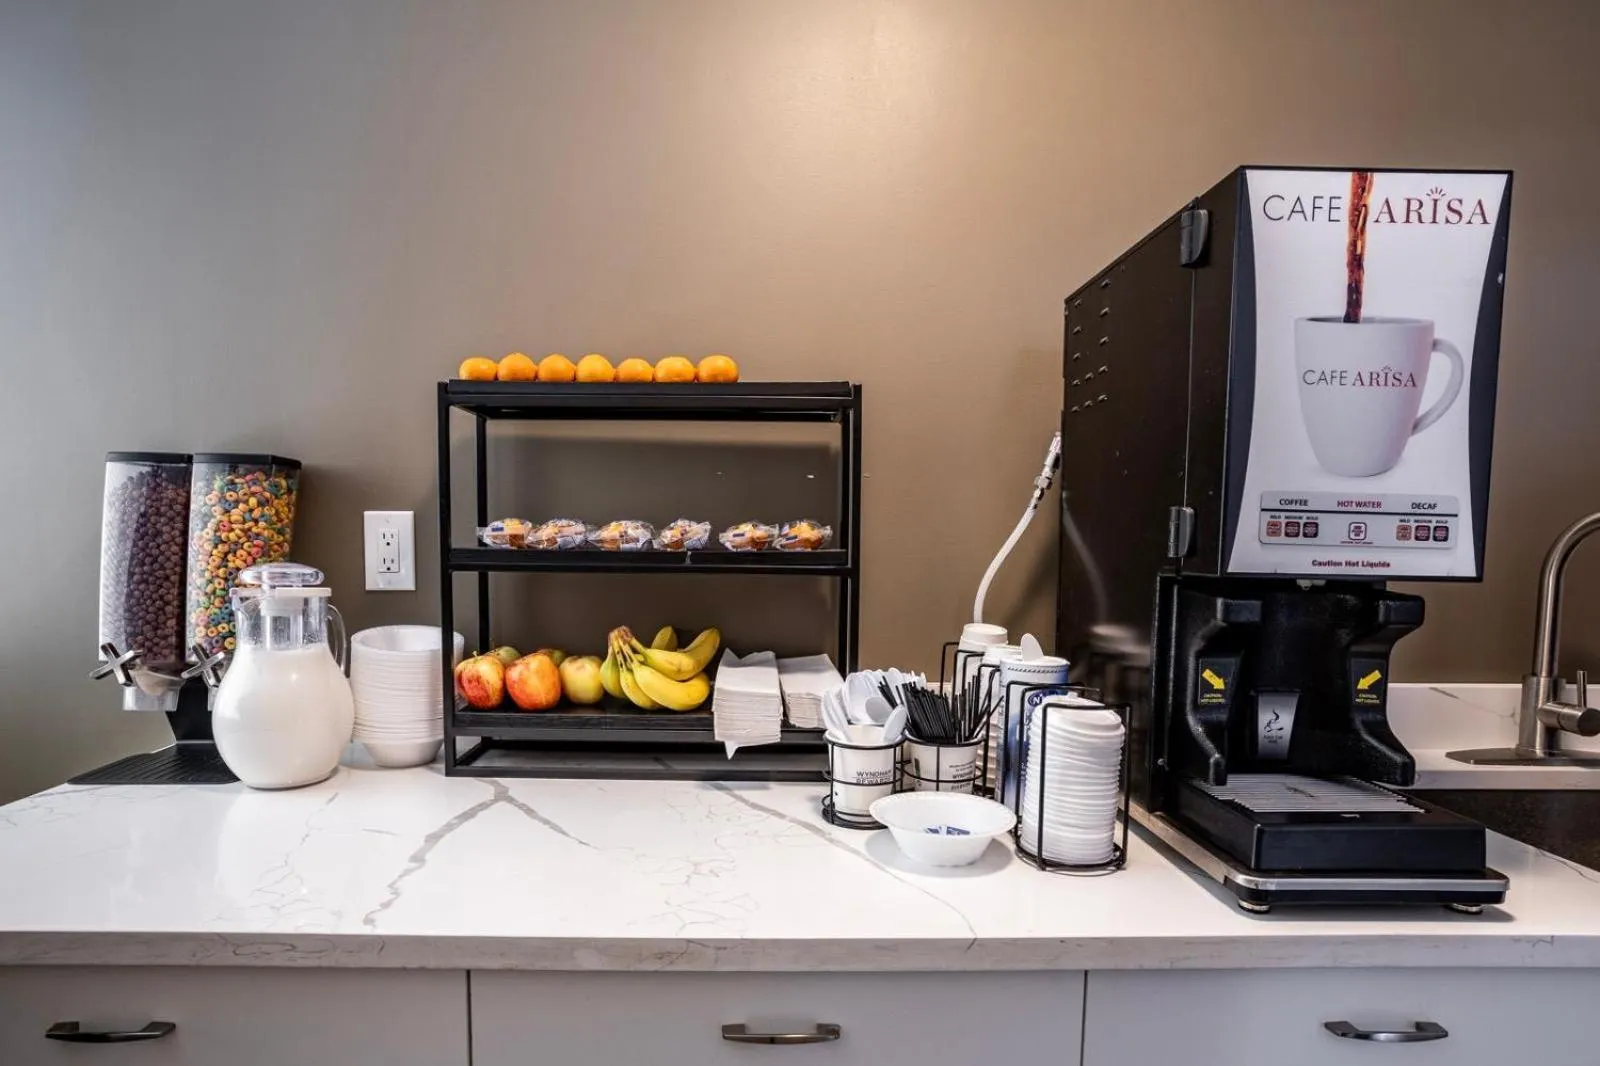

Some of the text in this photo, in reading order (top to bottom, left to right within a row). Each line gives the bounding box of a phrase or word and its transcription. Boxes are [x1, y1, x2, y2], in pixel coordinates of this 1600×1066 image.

[1262, 194, 1491, 225] CAFE ARISA
[1302, 369, 1418, 388] CAFE ARISA
[1279, 498, 1308, 507] COFFEE
[1337, 500, 1382, 509] HOT WATER
[1411, 502, 1437, 510] DECAF
[1312, 559, 1343, 567] Caution
[1361, 560, 1391, 569] Liquids
